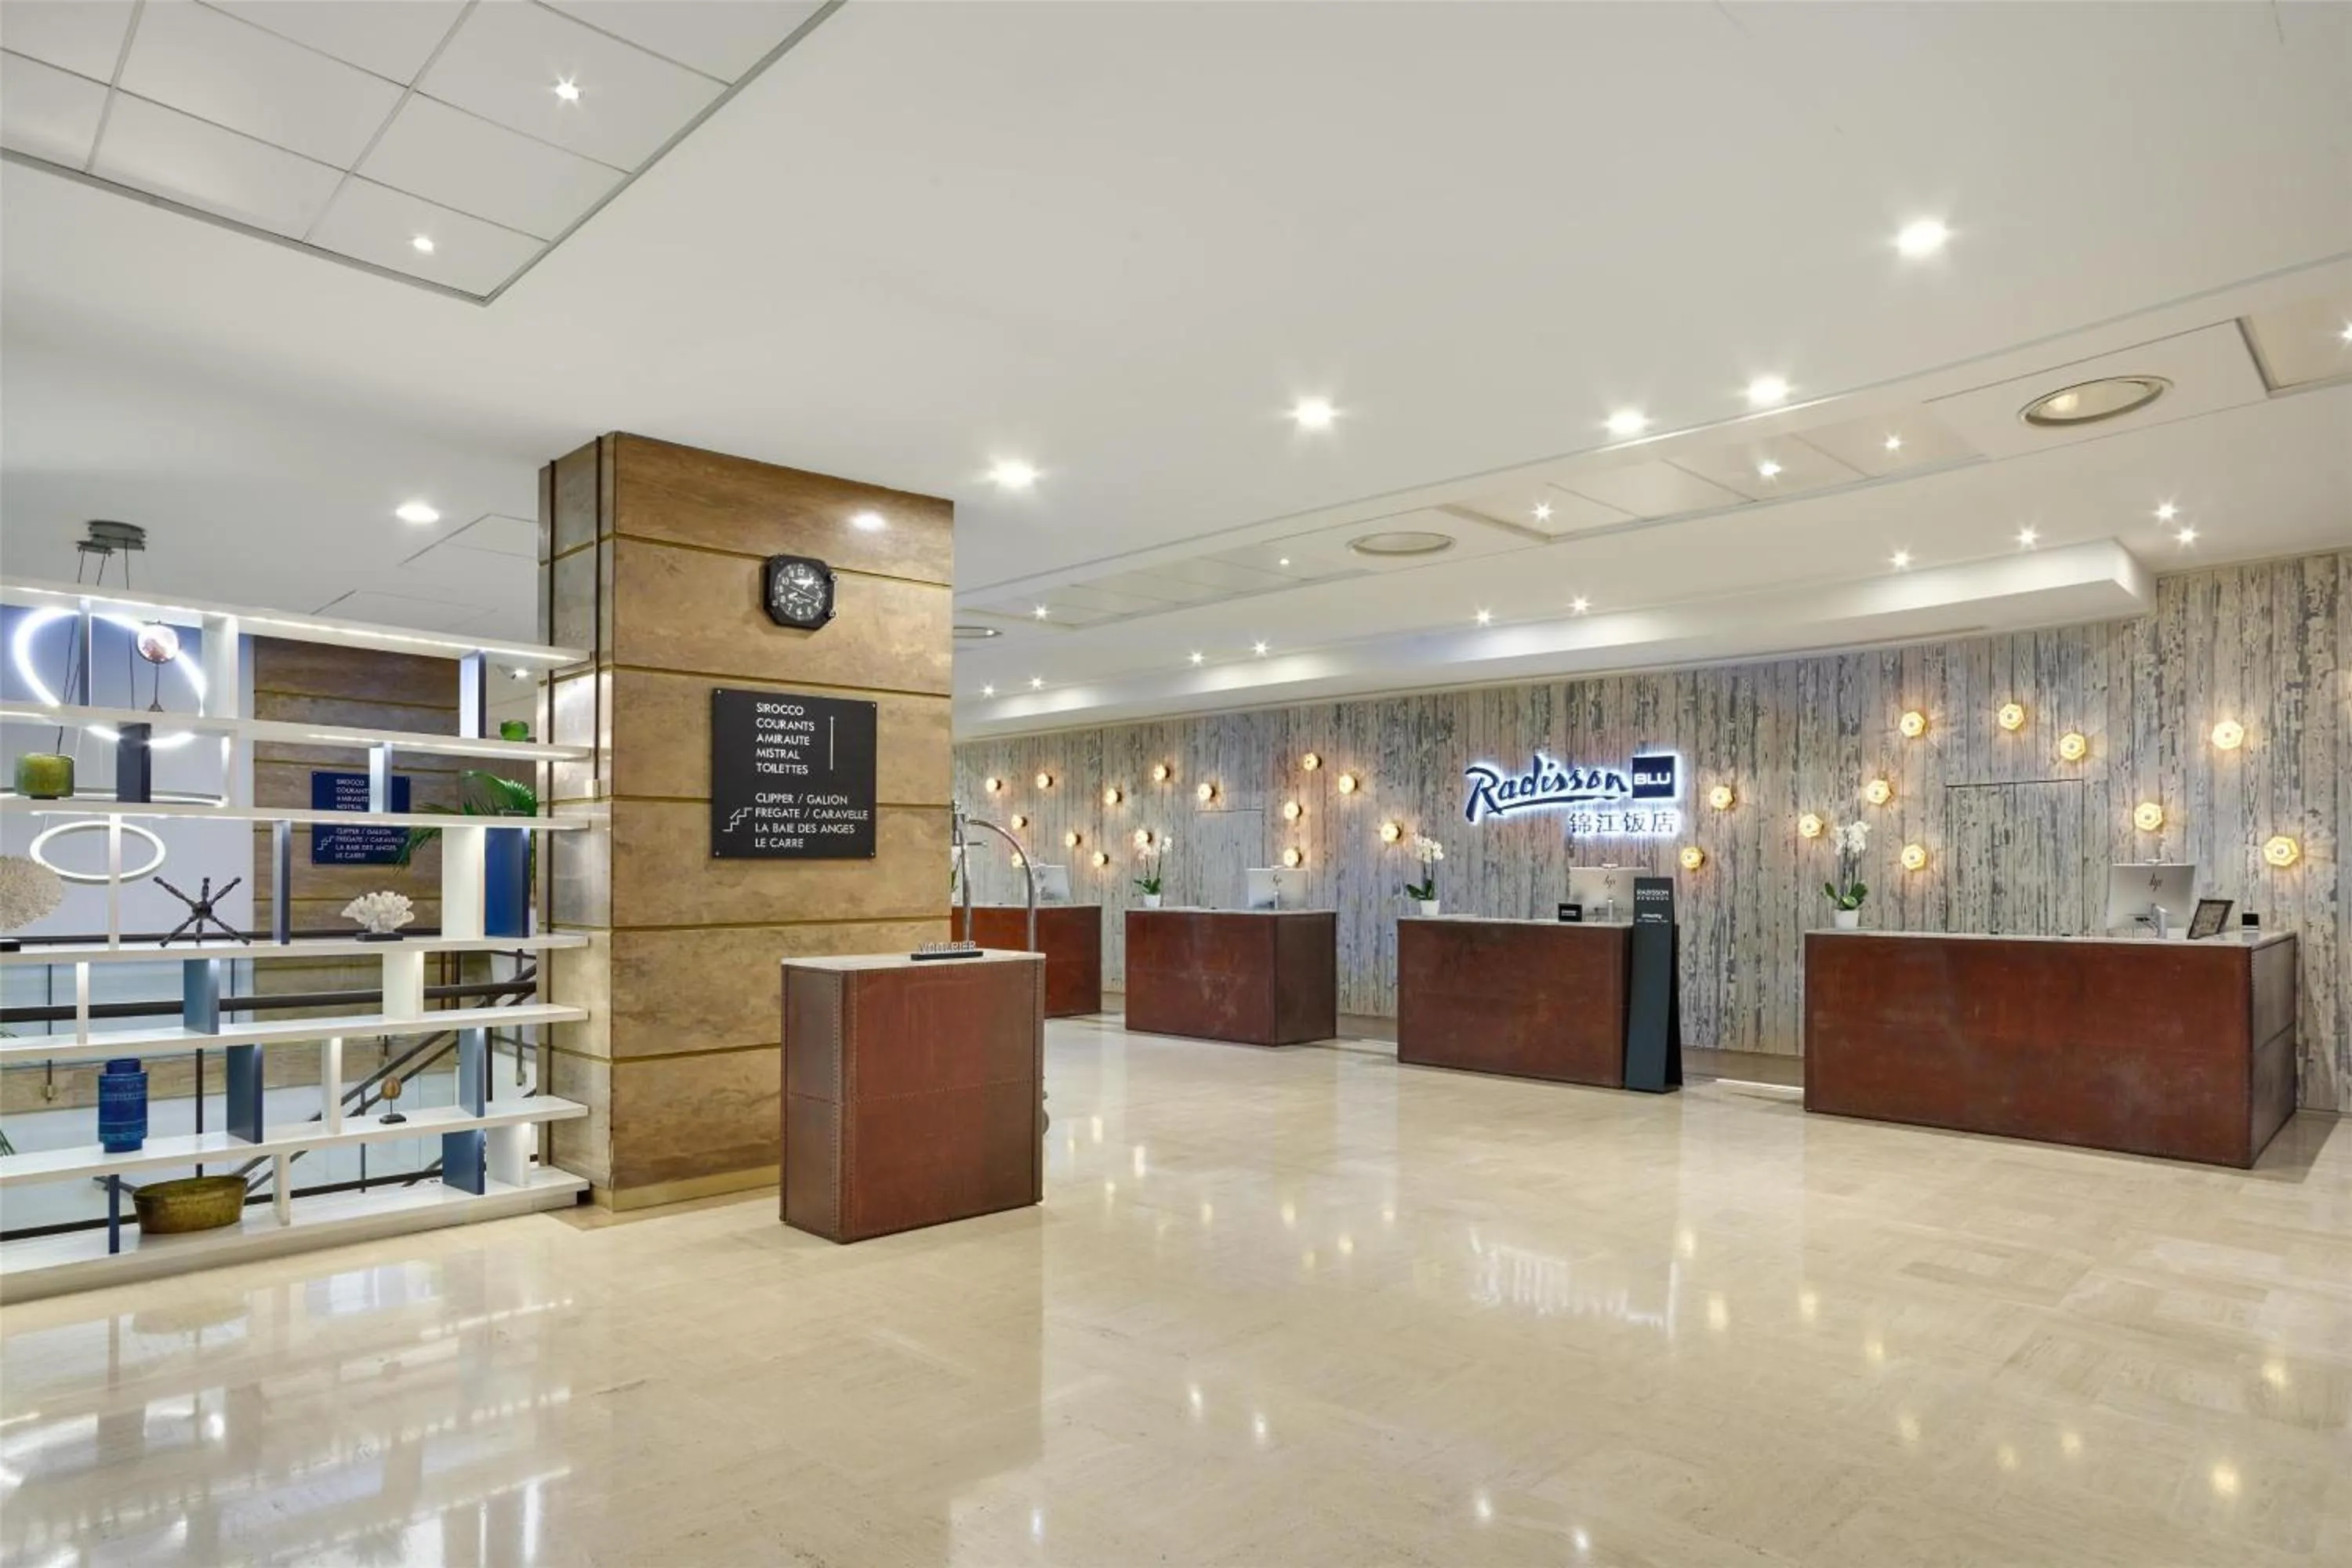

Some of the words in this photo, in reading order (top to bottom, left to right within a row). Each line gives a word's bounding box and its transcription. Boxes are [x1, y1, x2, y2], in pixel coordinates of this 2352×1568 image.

[756, 702, 804, 716] SIROCCO
[756, 717, 815, 731] COURANTS
[756, 733, 811, 746] AMIRAUTE
[756, 748, 800, 760] MISTRAL
[756, 763, 808, 775] TOILETTES
[1465, 755, 1628, 822] Radisson
[1633, 771, 1671, 785] BLU
[755, 793, 794, 804] CLIPPER
[807, 794, 848, 805] GALION
[755, 808, 800, 818] FREGATE
[813, 808, 869, 820] CARAVELLE
[755, 823, 769, 833] LA
[772, 823, 794, 833] BAIE
[798, 824, 816, 833] DES
[820, 824, 855, 834] ANGES
[1569, 812, 1675, 834] 锦江饭店
[755, 838, 766, 848] LE
[770, 838, 804, 848] CARRE
